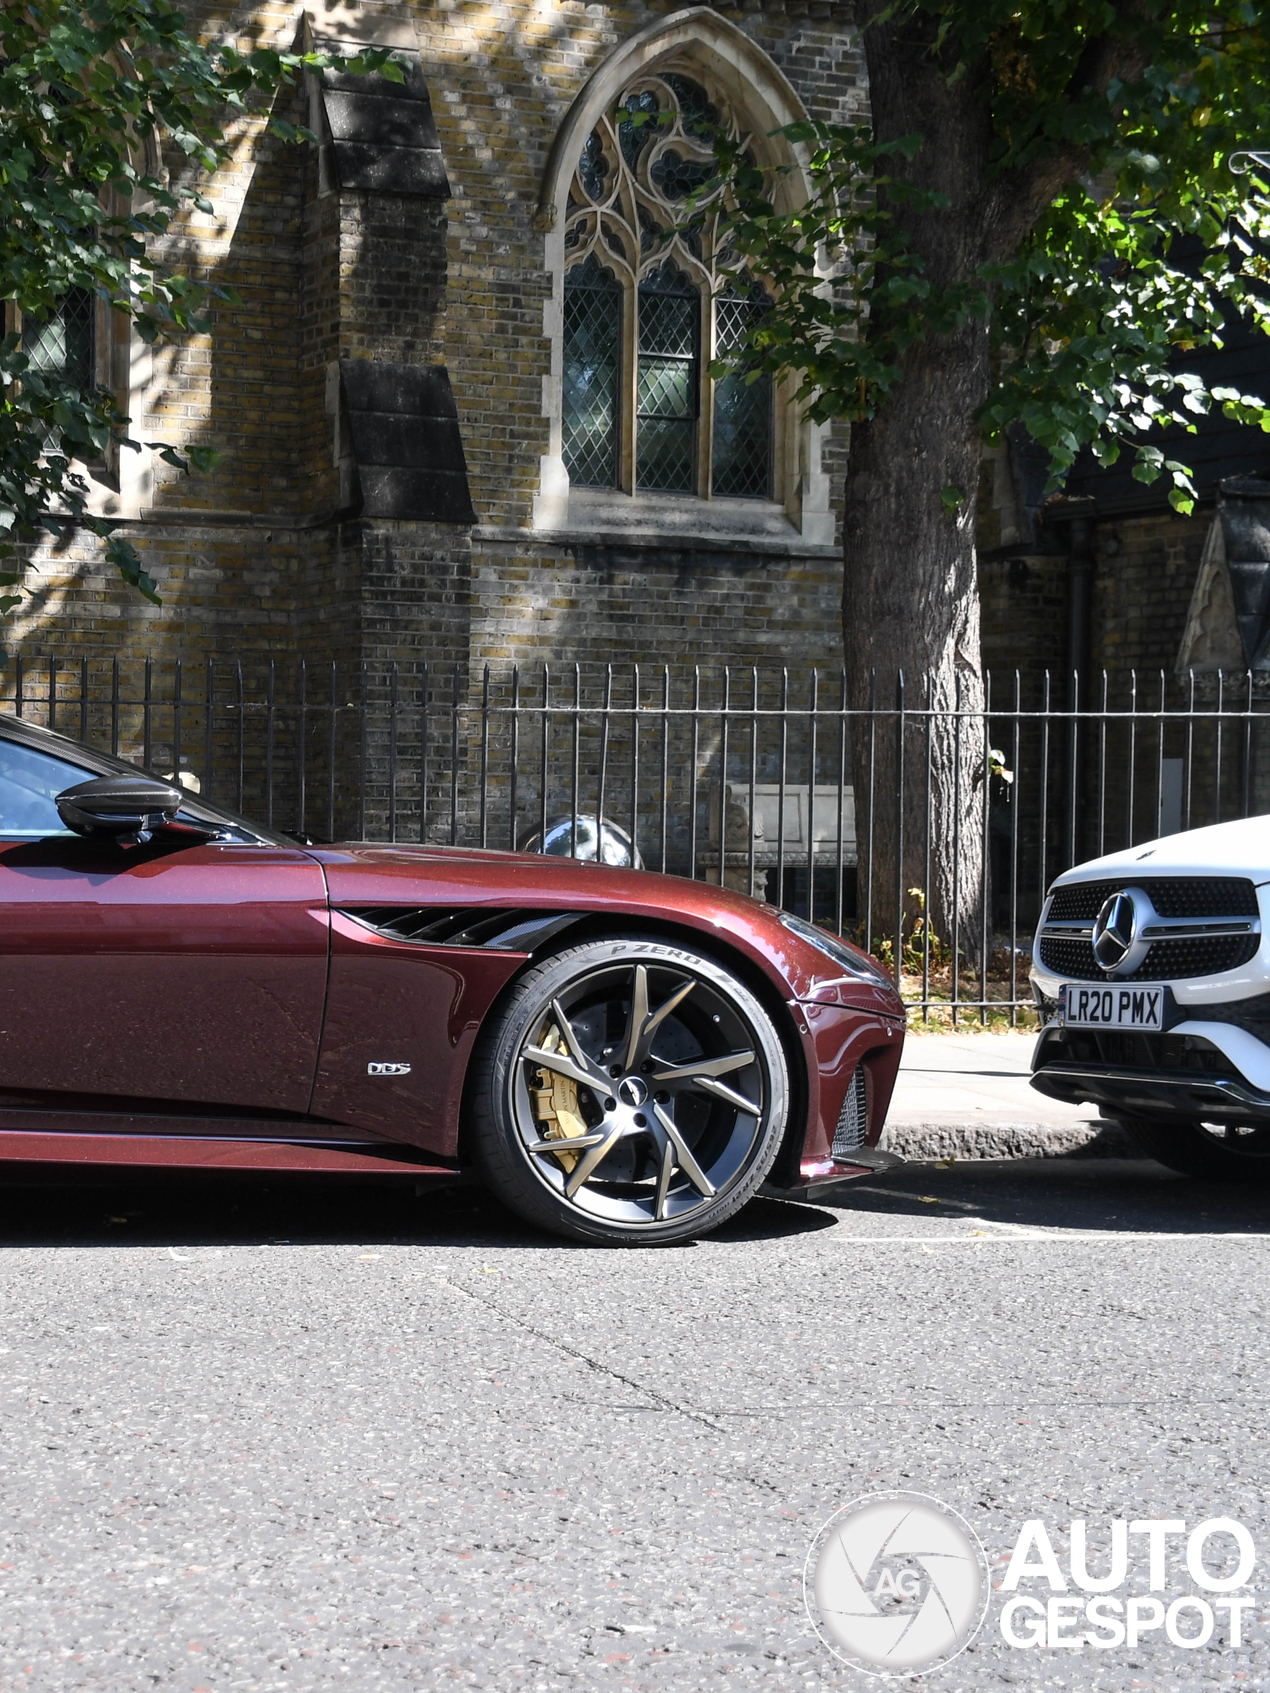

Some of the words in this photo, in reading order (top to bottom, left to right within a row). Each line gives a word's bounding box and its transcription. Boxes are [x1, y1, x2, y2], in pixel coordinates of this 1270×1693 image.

[611, 945, 627, 956] P
[632, 944, 701, 965] ZERO
[1067, 990, 1113, 1022] LR20
[1118, 991, 1160, 1025] PMX
[367, 1062, 411, 1075] DBS
